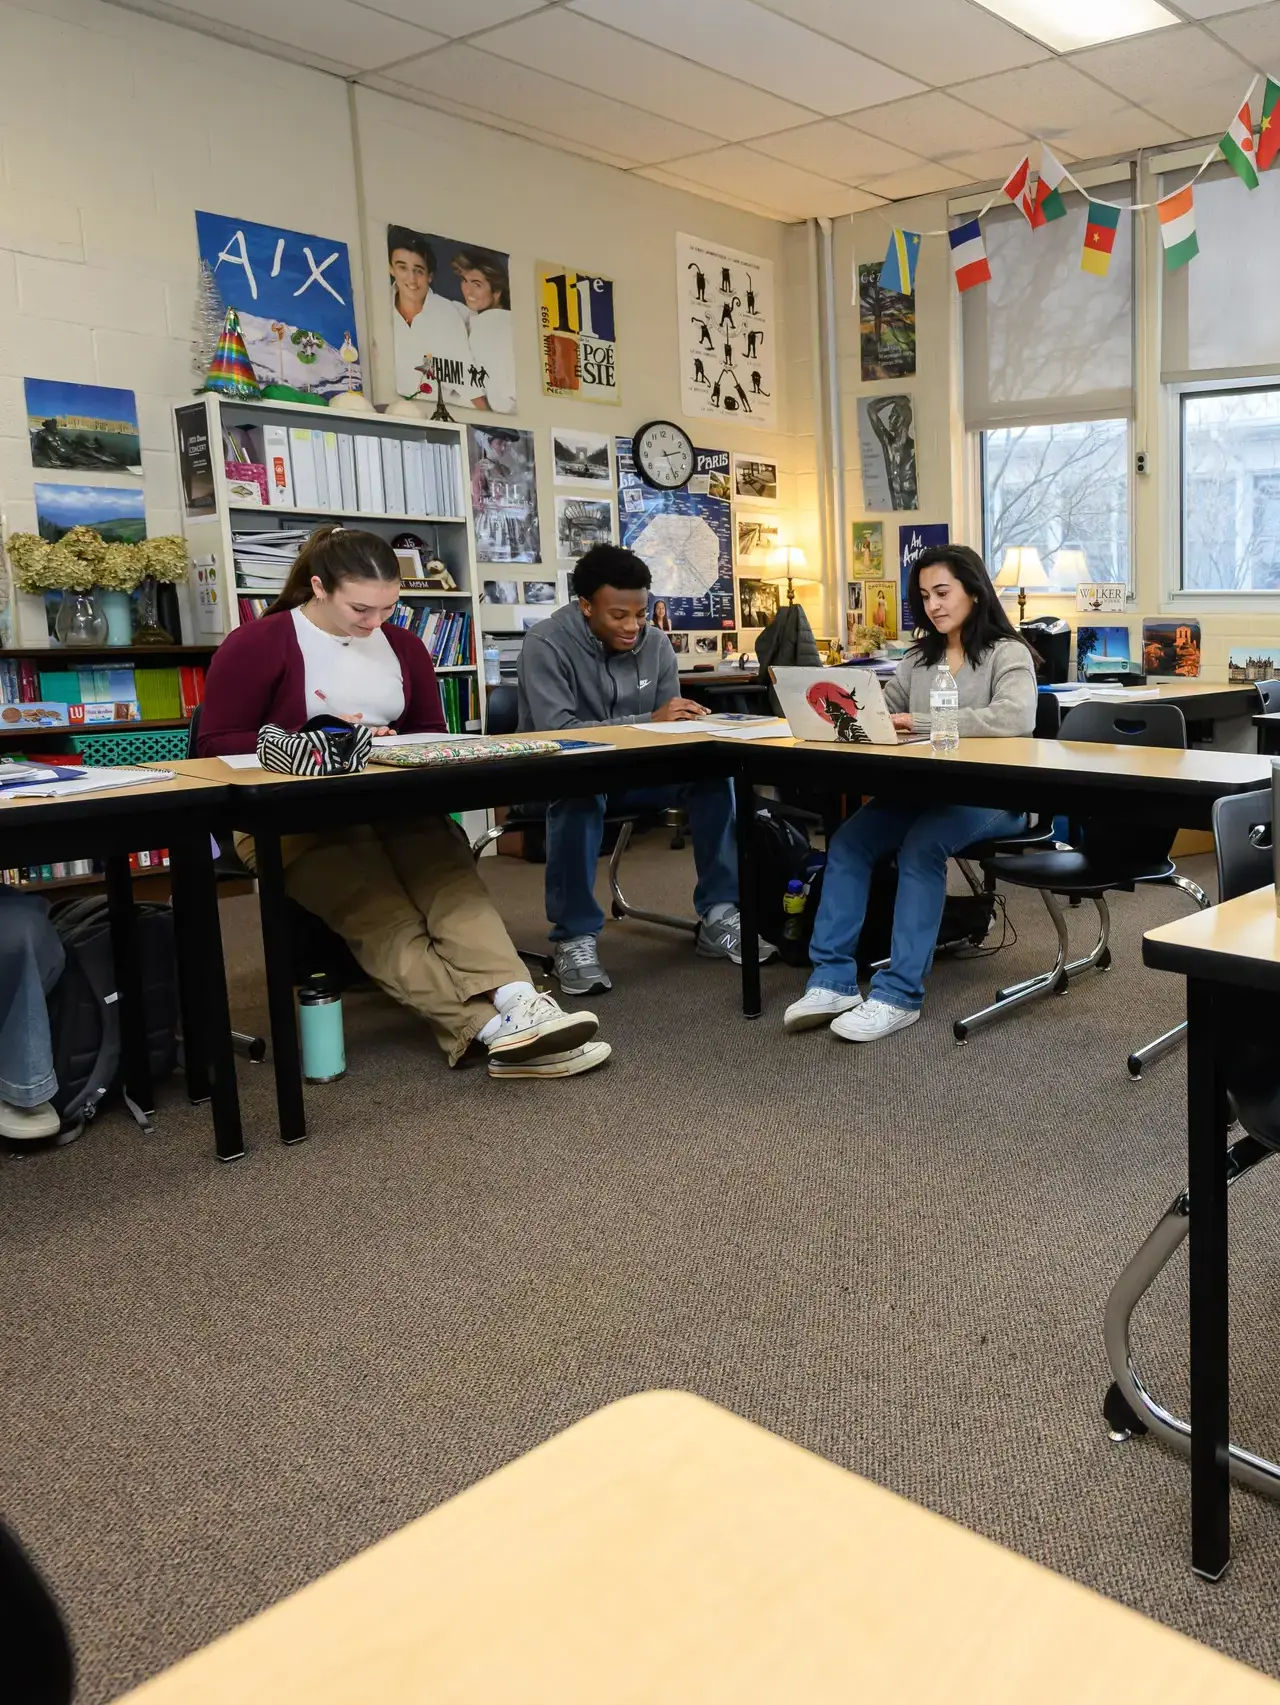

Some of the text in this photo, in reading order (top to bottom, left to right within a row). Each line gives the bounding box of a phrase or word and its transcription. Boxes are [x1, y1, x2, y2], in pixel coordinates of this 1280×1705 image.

[214, 230, 345, 306] AIX
[541, 306, 550, 329] 1993
[543, 335, 552, 357] JUIN
[583, 344, 615, 366] POÉ
[583, 361, 616, 387] SIE
[697, 453, 729, 472] PARIS
[70, 705, 83, 719] LU
[720, 934, 738, 949] N
